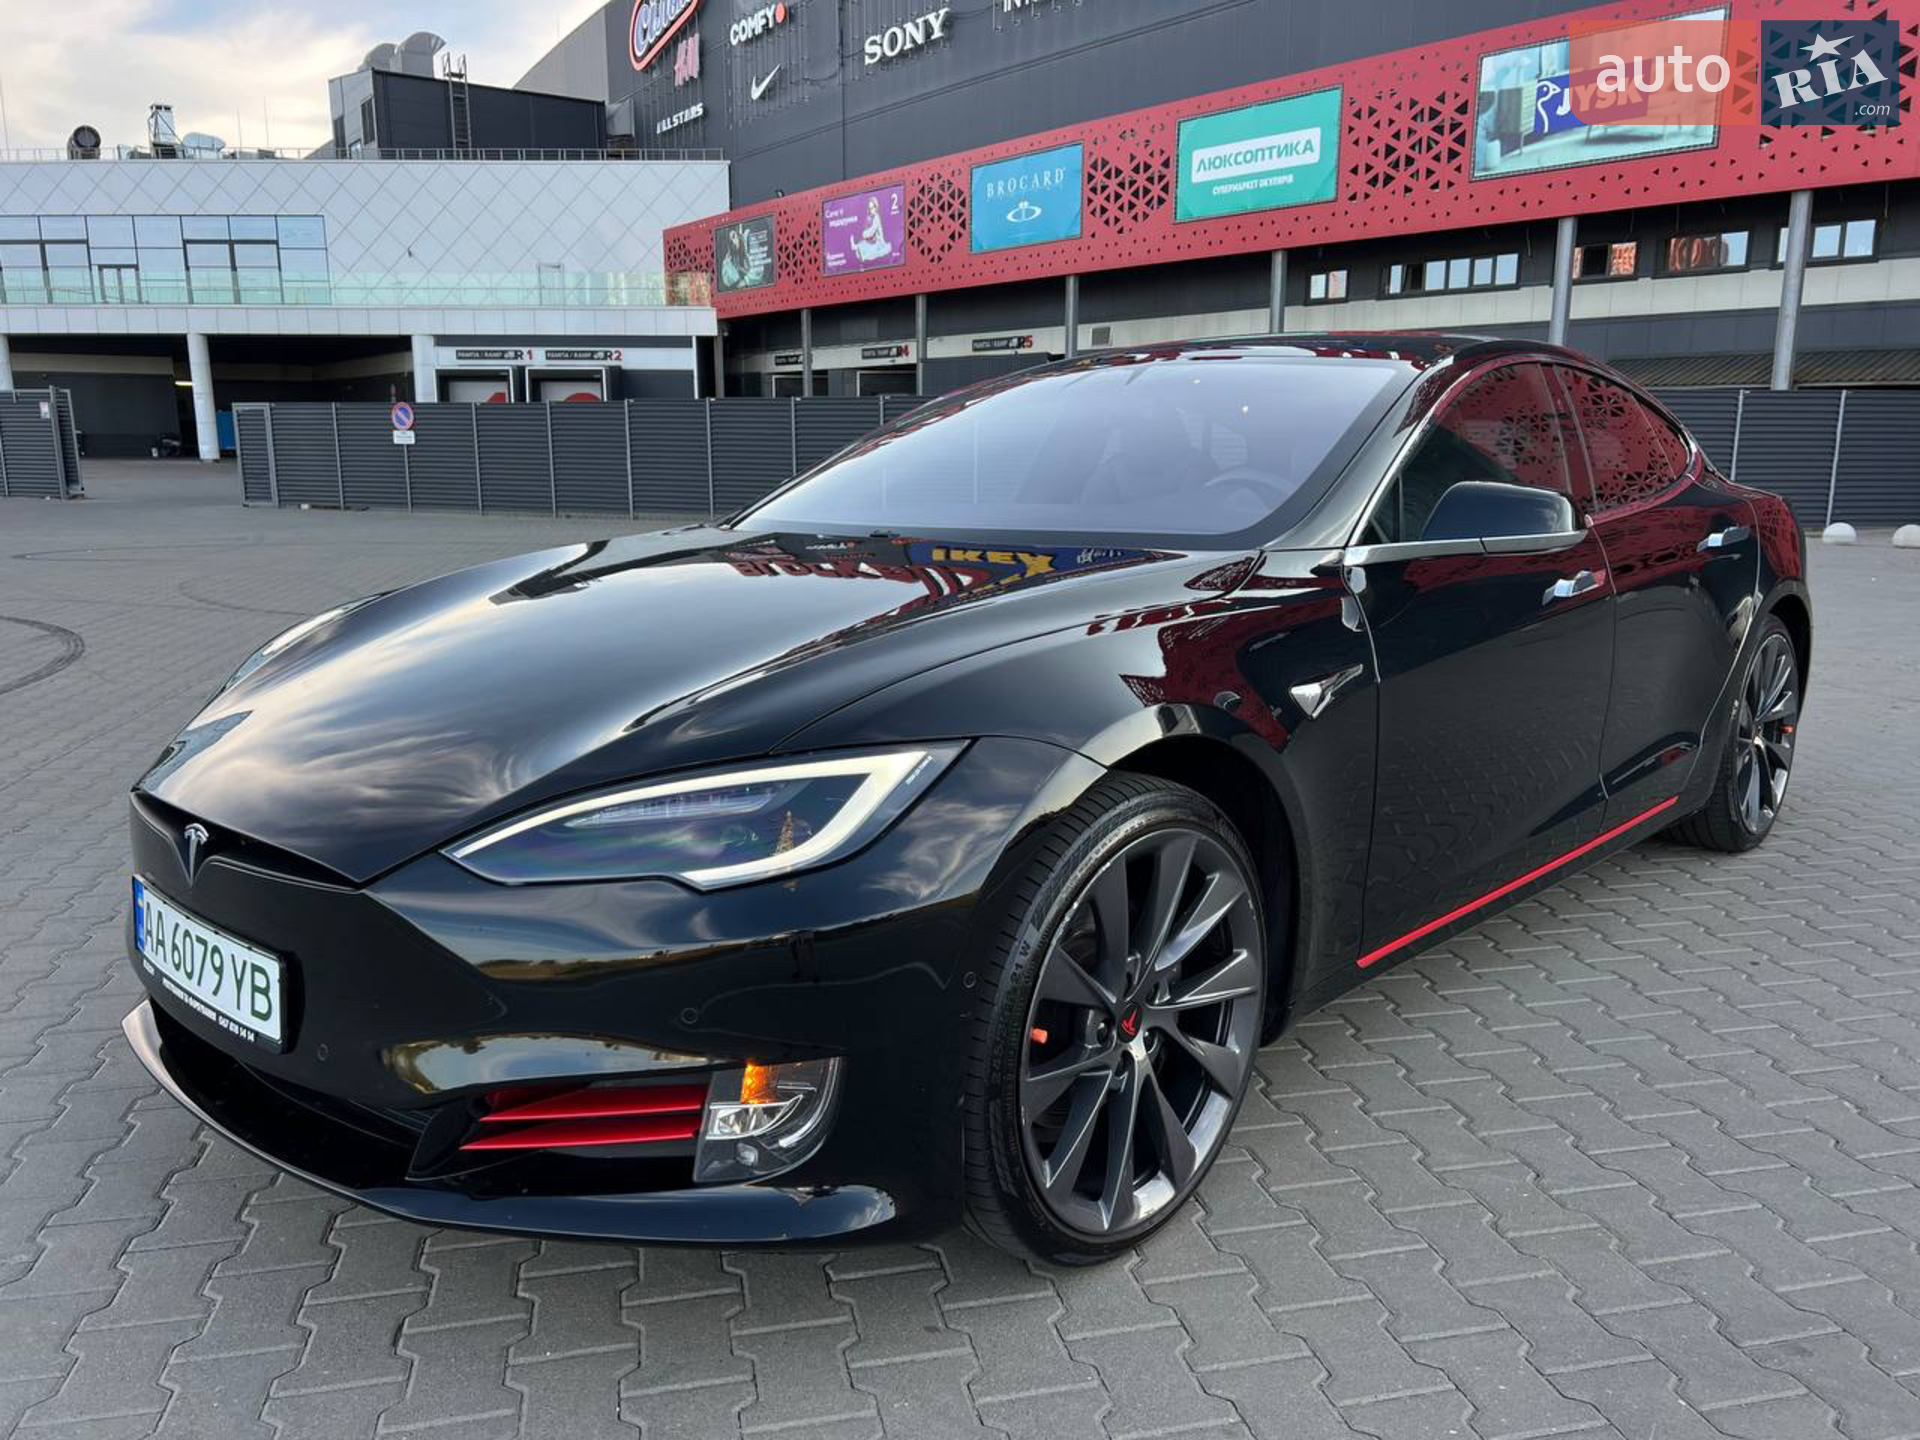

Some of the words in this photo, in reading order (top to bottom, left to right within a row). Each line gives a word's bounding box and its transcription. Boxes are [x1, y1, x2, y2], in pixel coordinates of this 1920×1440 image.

[730, 4, 776, 46] COMFY
[864, 7, 950, 65] SONY
[1555, 74, 1648, 117] JYSK
[1196, 138, 1316, 173] ЛЮКСОПТИКА
[890, 193, 899, 210] 2
[986, 168, 1065, 198] BROCARD
[144, 901, 167, 963] AA
[171, 922, 224, 997] 6079
[230, 953, 273, 1021] YB
